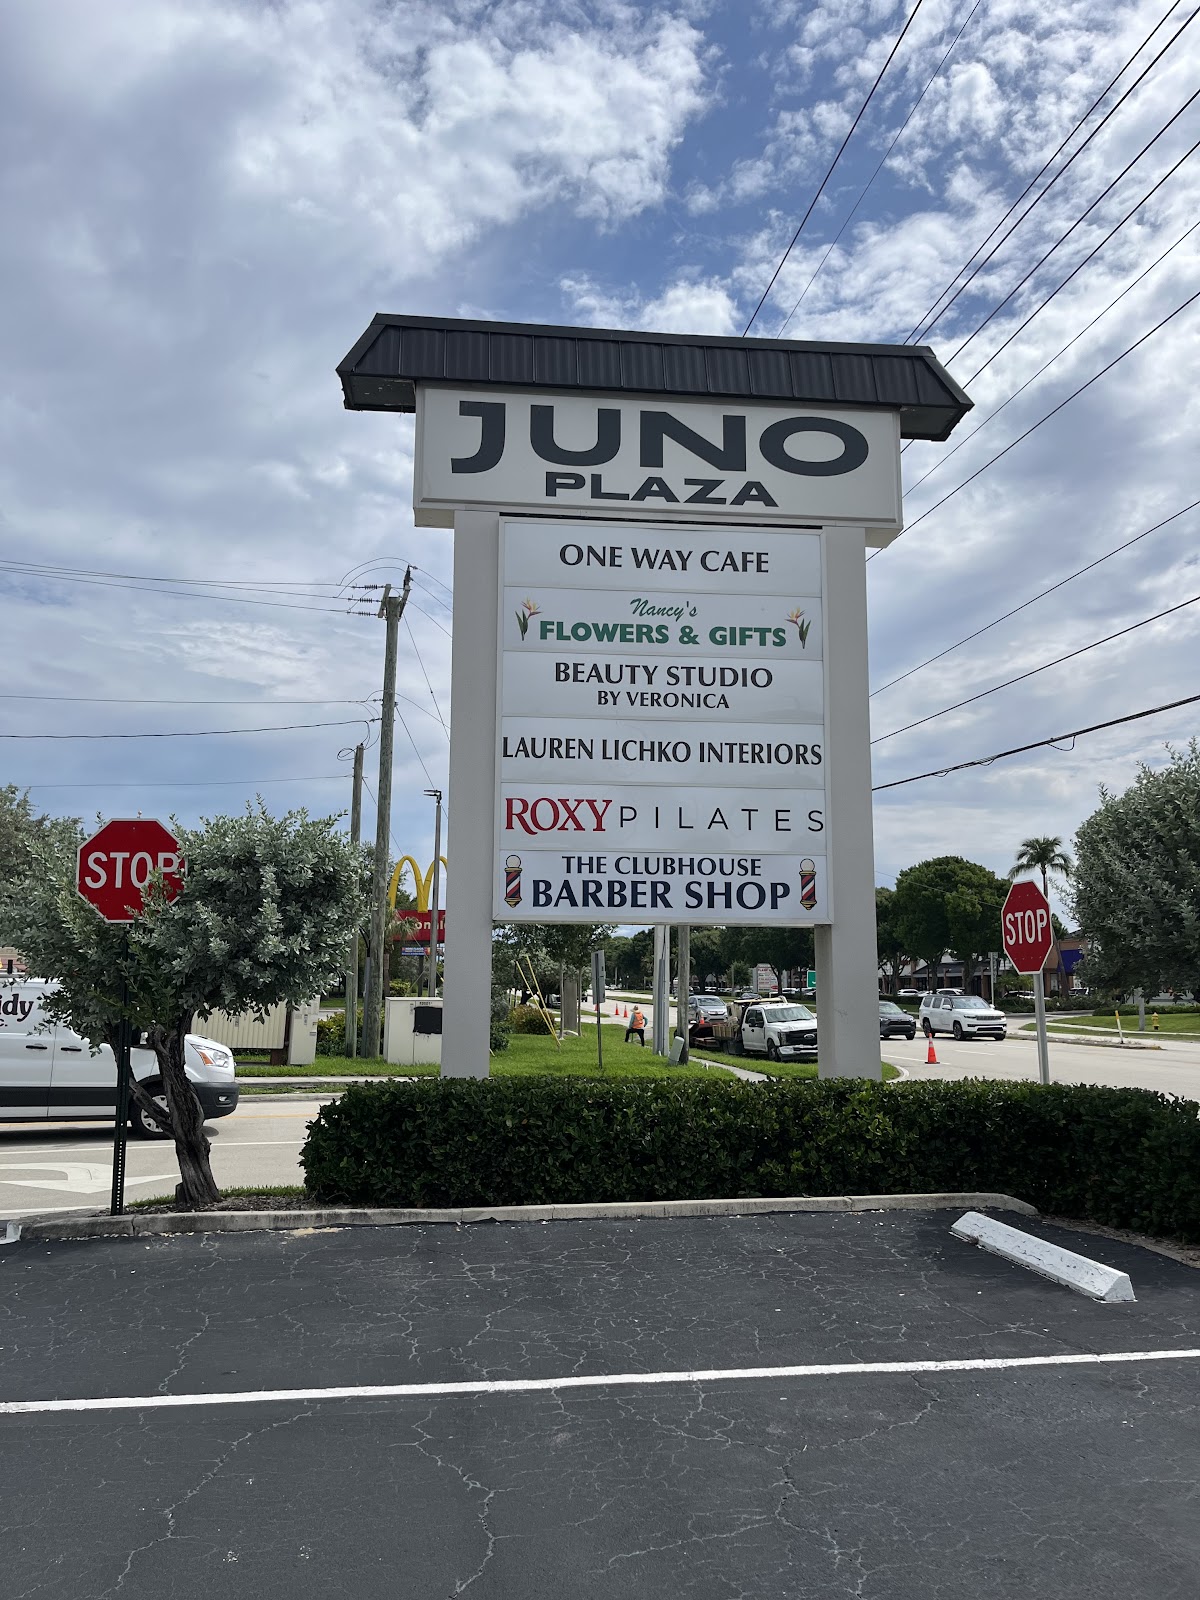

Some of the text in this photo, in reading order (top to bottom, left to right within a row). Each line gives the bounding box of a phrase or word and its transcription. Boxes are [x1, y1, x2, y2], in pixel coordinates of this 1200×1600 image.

[451, 401, 870, 477] JUNO
[545, 471, 780, 508] PLAZA
[560, 544, 768, 573] ONE WAY CAFE
[630, 598, 697, 622] Nancy's
[540, 621, 786, 647] FLOWERS & GIFTS
[556, 663, 772, 688] BEAUTY STUDIO
[598, 691, 729, 708] BY VERONICA
[503, 737, 821, 765] LAUREN LICHKO INTERIORS
[505, 797, 823, 835] ROXY PILATES
[85, 852, 181, 889] STOP
[562, 856, 762, 877] THE CLUBHOUSE
[533, 880, 790, 909] BARBER SHOP
[1004, 906, 1047, 946] STOP
